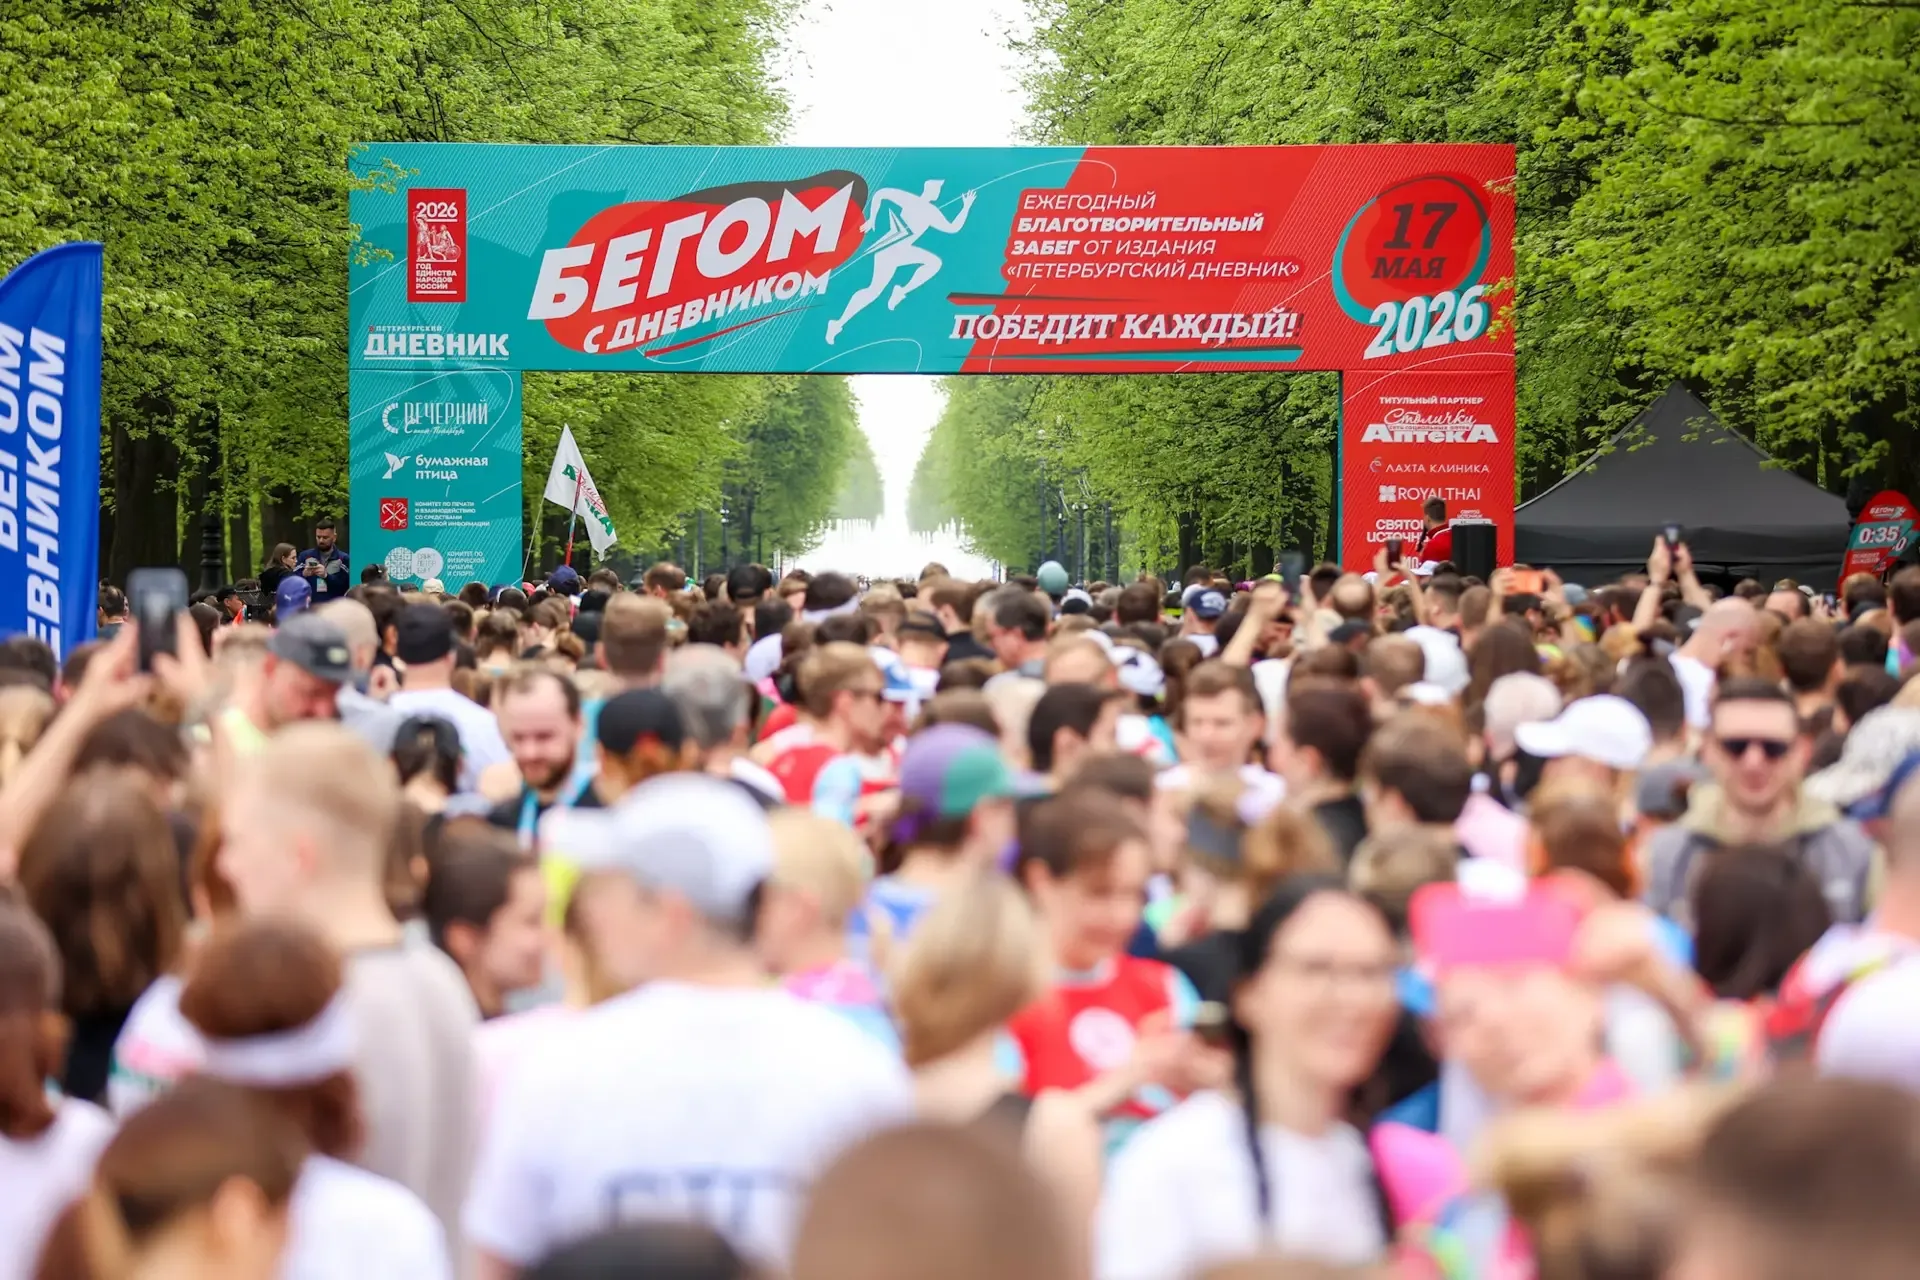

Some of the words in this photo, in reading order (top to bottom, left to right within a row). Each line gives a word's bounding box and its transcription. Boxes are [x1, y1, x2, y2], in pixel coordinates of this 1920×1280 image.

[416, 202, 459, 218] 2026
[1023, 191, 1157, 212] ЕЖЕГОДНЫЙ
[1017, 213, 1264, 232] БЛАГОТВОРИТЕЛЬНЫЙ
[1383, 203, 1458, 249] 17
[527, 181, 854, 320] БЕГОМ
[1011, 240, 1080, 255] ЗАБЕГ
[1084, 240, 1113, 255] ОТ
[1115, 240, 1216, 257] ИЗДАНИЯ
[1006, 259, 1187, 279] «ПЕТЕРБУРГСКИЙ
[1188, 262, 1300, 280] ДНЕВНИК»
[1370, 257, 1447, 279] МАЯ
[583, 325, 605, 353] С
[606, 269, 832, 350] ДНЕВНИКОМ
[949, 314, 1117, 345] ПОБЕДИТ
[1120, 307, 1299, 345] КАЖДЫЙ!
[1363, 284, 1487, 360] 2026
[364, 333, 510, 356] ДНЕВНИК
[1379, 396, 1438, 405] ТИТУЛЬНЫЙ
[1439, 397, 1484, 405] ПАРТНЕР
[404, 399, 488, 425] ВЕЧЕРНИЙ
[1384, 408, 1477, 425] Столички
[415, 454, 489, 468] бумажная
[1385, 464, 1426, 473] ЛАХТА
[1430, 464, 1490, 473] КЛИНИКА
[415, 469, 458, 481] птица
[26, 326, 65, 663] ЕВНИКОМ
[1366, 531, 1428, 542] ИСТОЧН
[1859, 526, 1900, 544] 0:35
